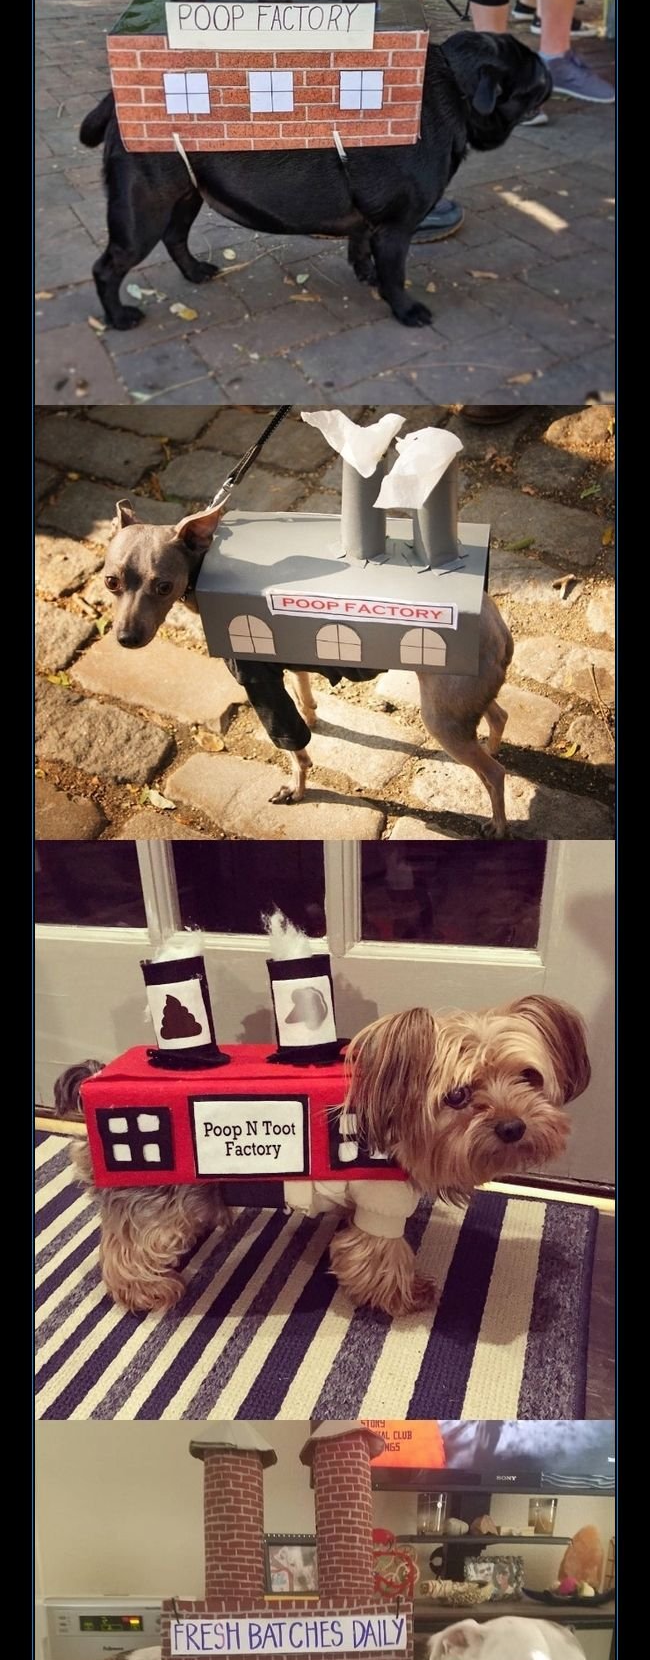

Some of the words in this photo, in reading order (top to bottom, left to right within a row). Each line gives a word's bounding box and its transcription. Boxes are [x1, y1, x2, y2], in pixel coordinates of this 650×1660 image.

[178, 4, 245, 31] POOP
[257, 4, 359, 33] FACTORY
[282, 597, 340, 611] POOP
[345, 603, 443, 620] FACTORY
[203, 1122, 242, 1140] Poop
[245, 1121, 258, 1136] N
[262, 1120, 296, 1136] Toot
[225, 1141, 281, 1159] Factory
[393, 1430, 413, 1440] CLUB
[174, 1621, 240, 1651] FRESH
[248, 1619, 344, 1650] BATCHES
[352, 1618, 405, 1649] DAILY
